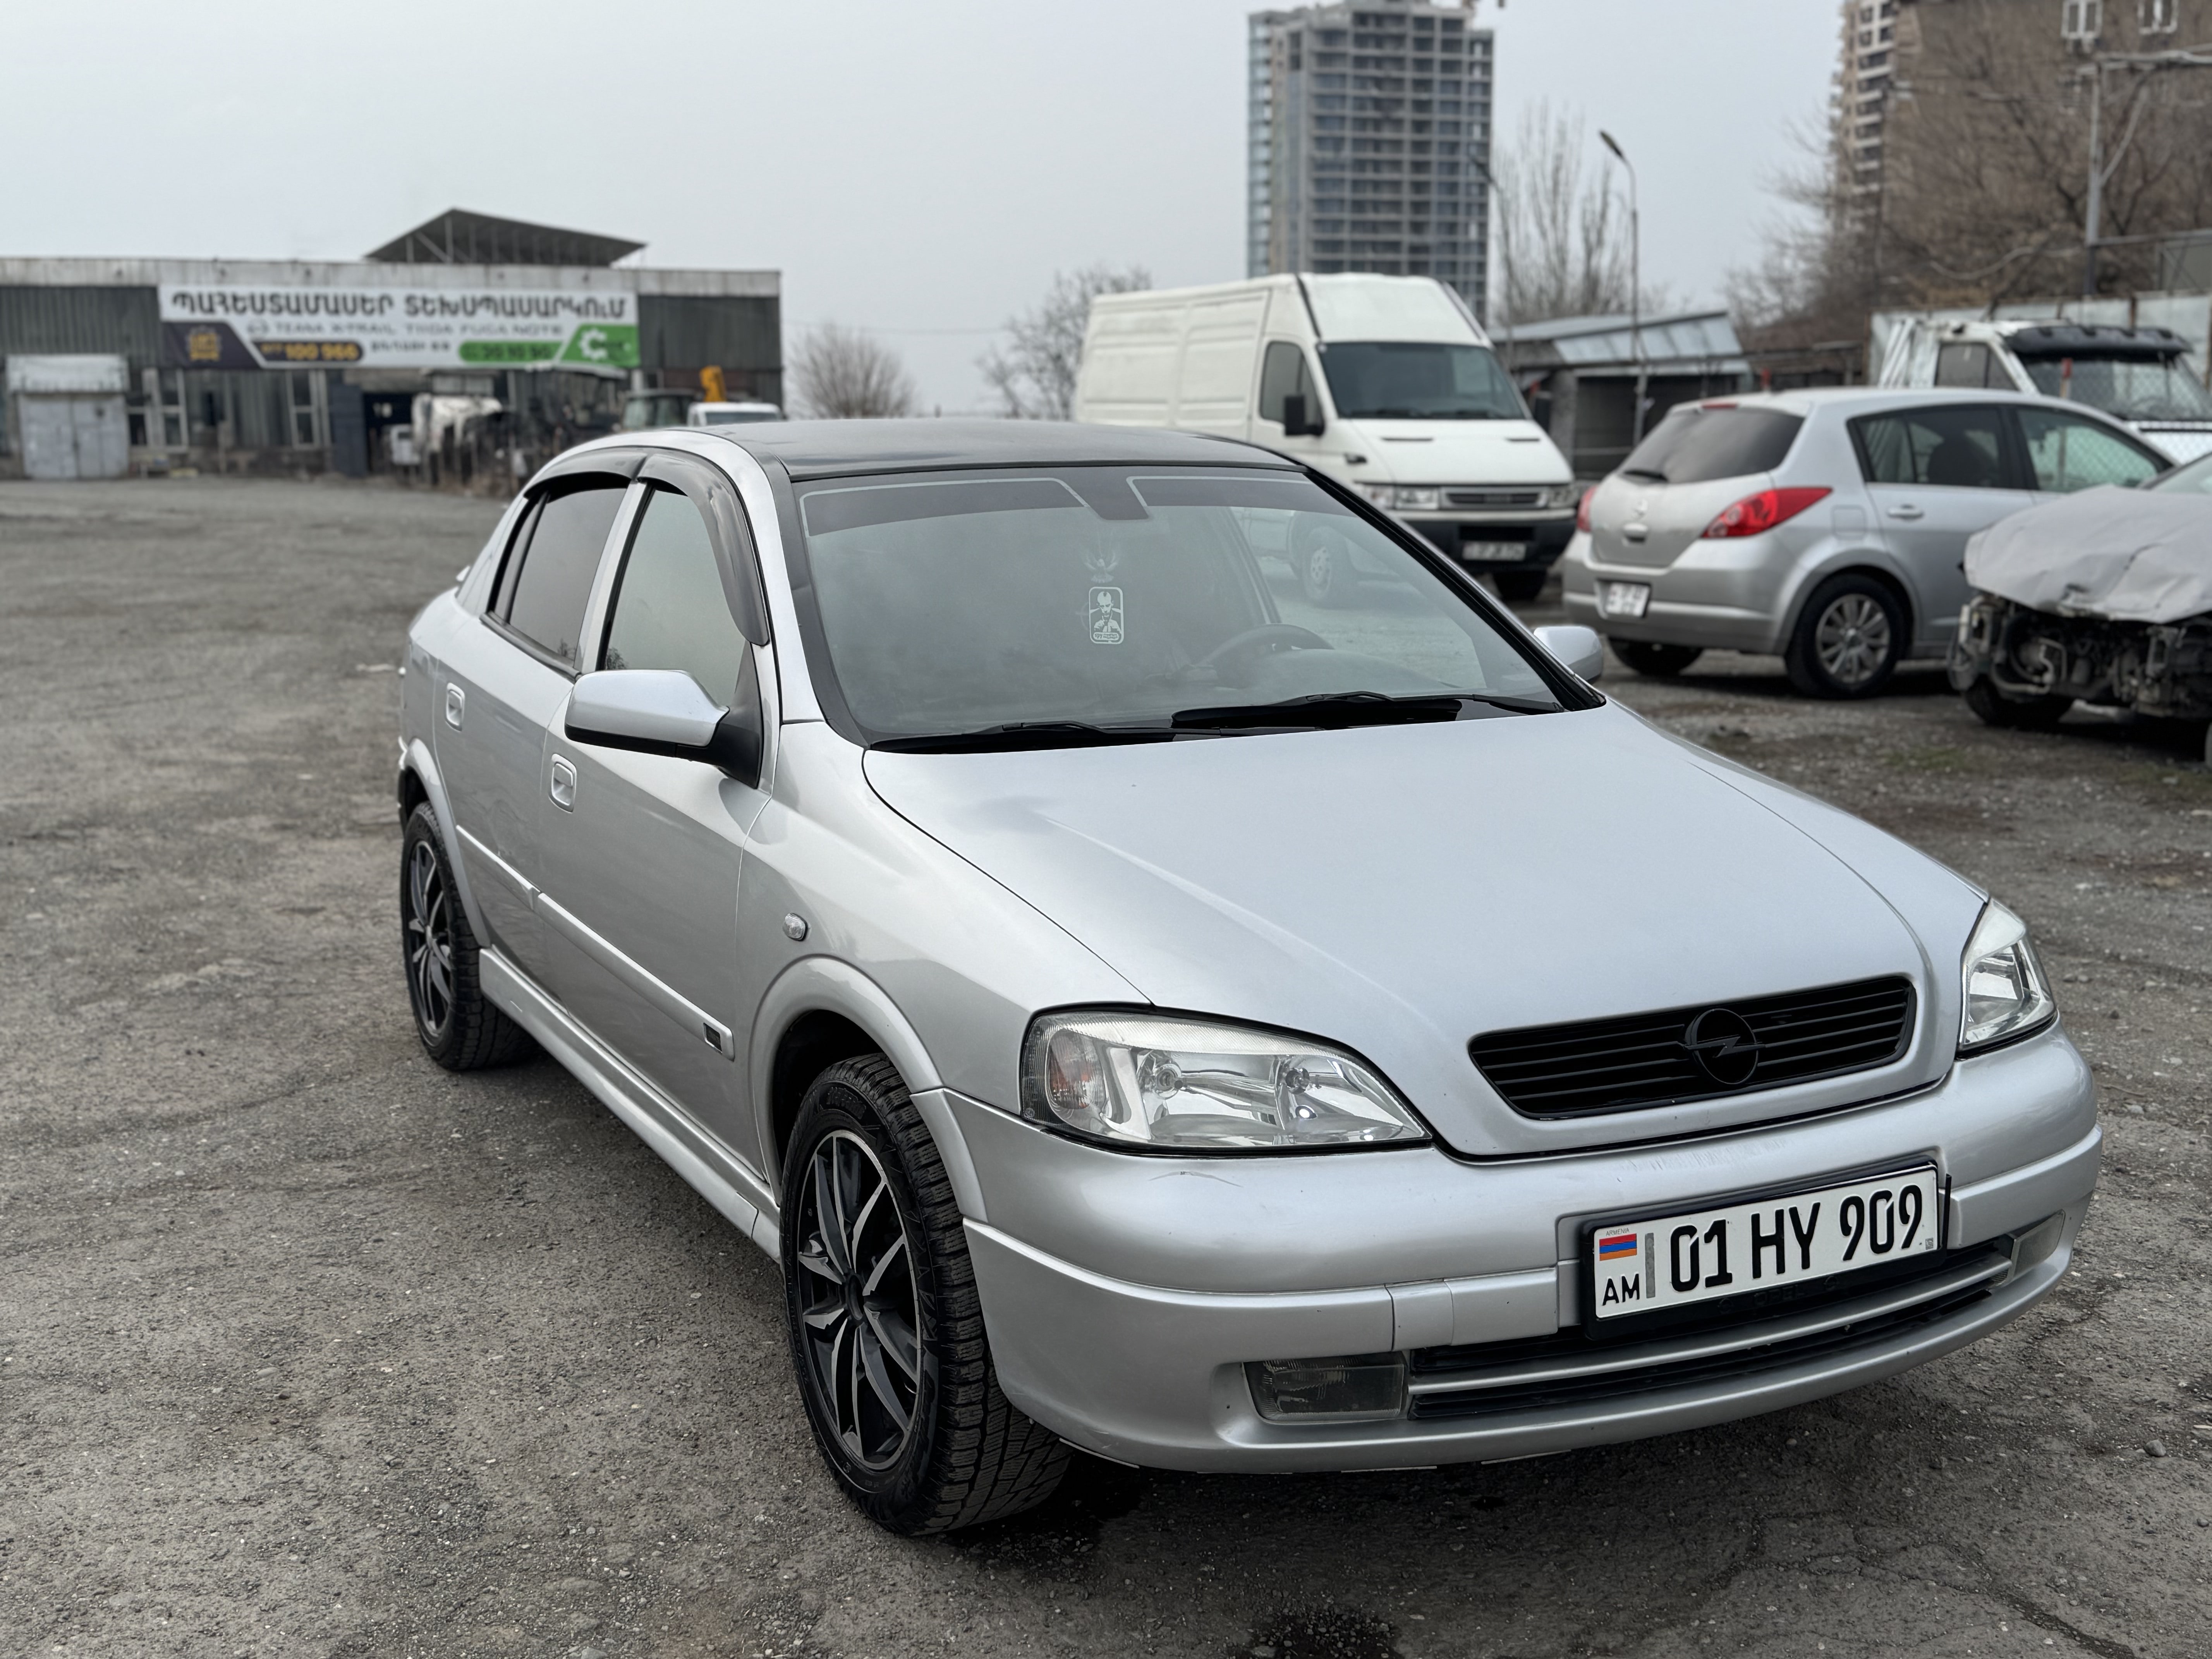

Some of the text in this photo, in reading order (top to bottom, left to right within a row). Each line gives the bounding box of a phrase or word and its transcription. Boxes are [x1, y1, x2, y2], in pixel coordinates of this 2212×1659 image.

[275, 323, 324, 333] TEANA
[1606, 1228, 1630, 1236] ARMENIA
[1670, 1185, 1922, 1292] 01 HY 909
[1602, 1273, 1640, 1306] AM
